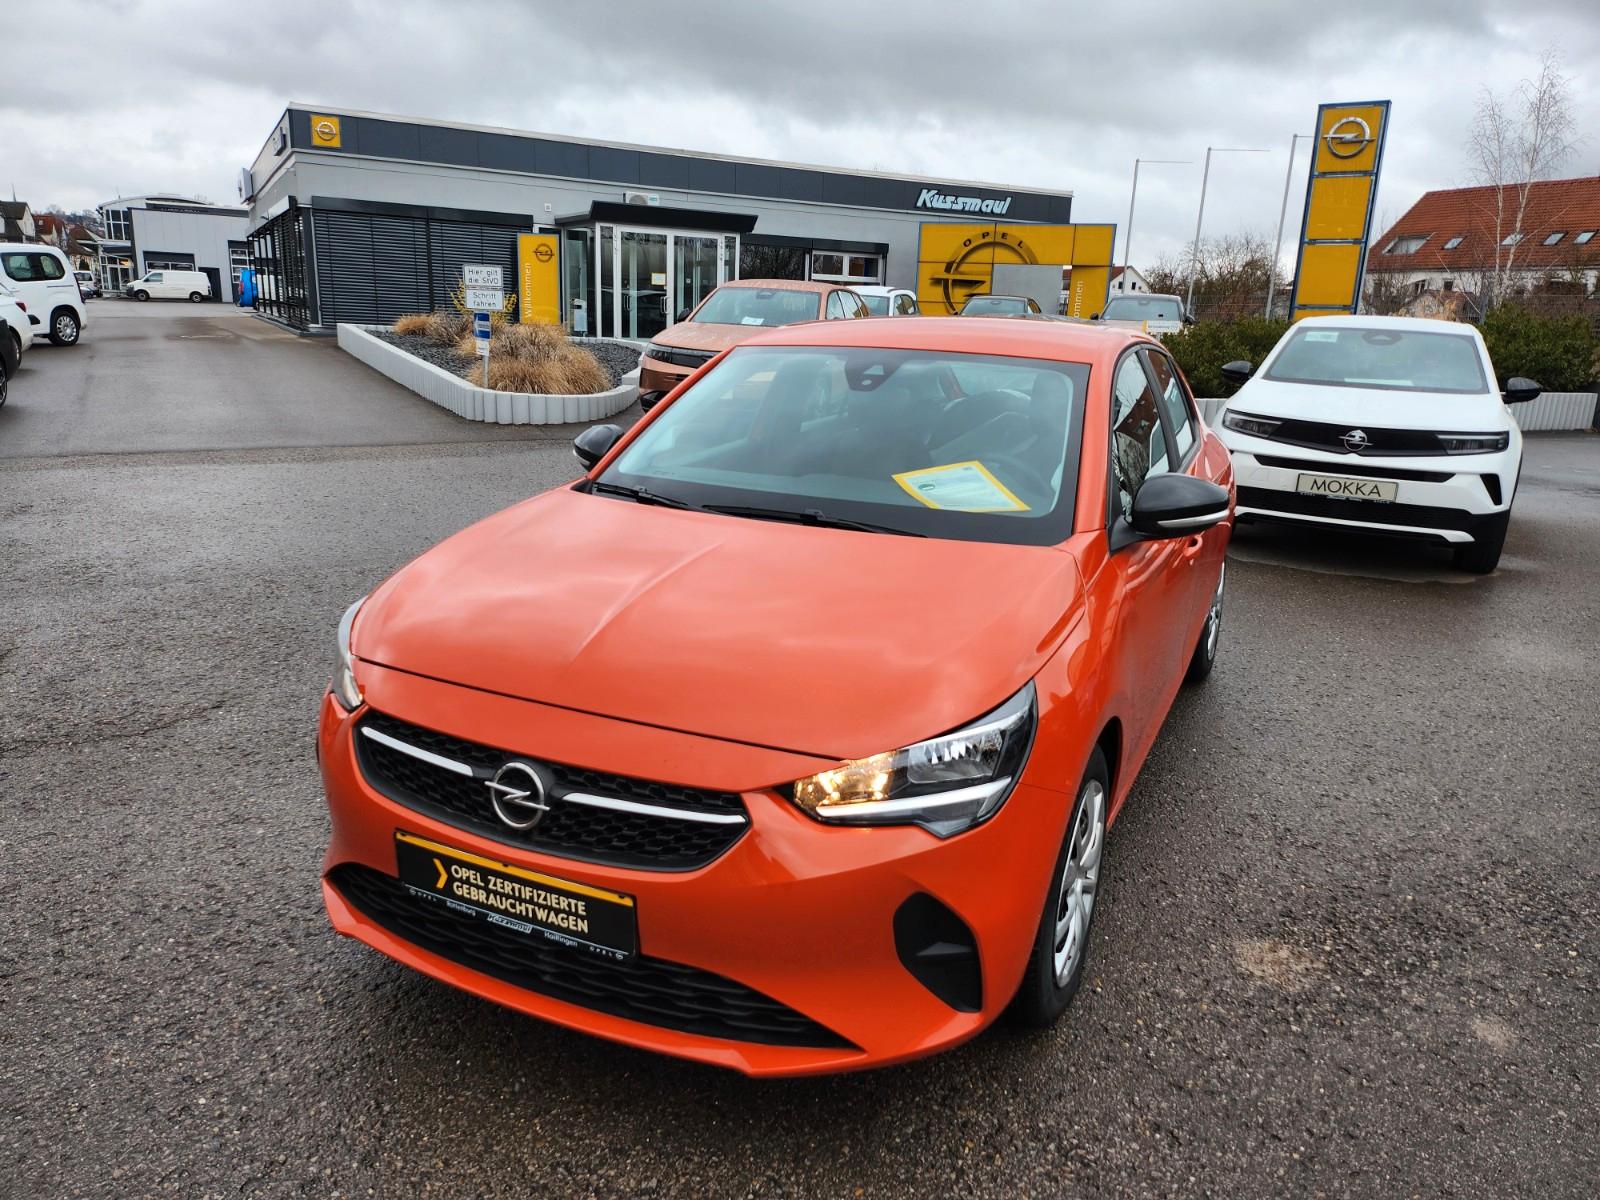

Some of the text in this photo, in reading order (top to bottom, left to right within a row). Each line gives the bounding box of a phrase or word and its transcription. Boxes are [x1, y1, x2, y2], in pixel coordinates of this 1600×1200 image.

[916, 188, 1012, 215] Kussmaul
[963, 231, 1024, 248] OPEL
[524, 262, 532, 318] Willkommen
[1310, 478, 1381, 498] MOKKA
[451, 865, 587, 916] OPEL ZERTIFIZIERTE
[452, 881, 589, 934] GEBRAUCHTWAGEN
